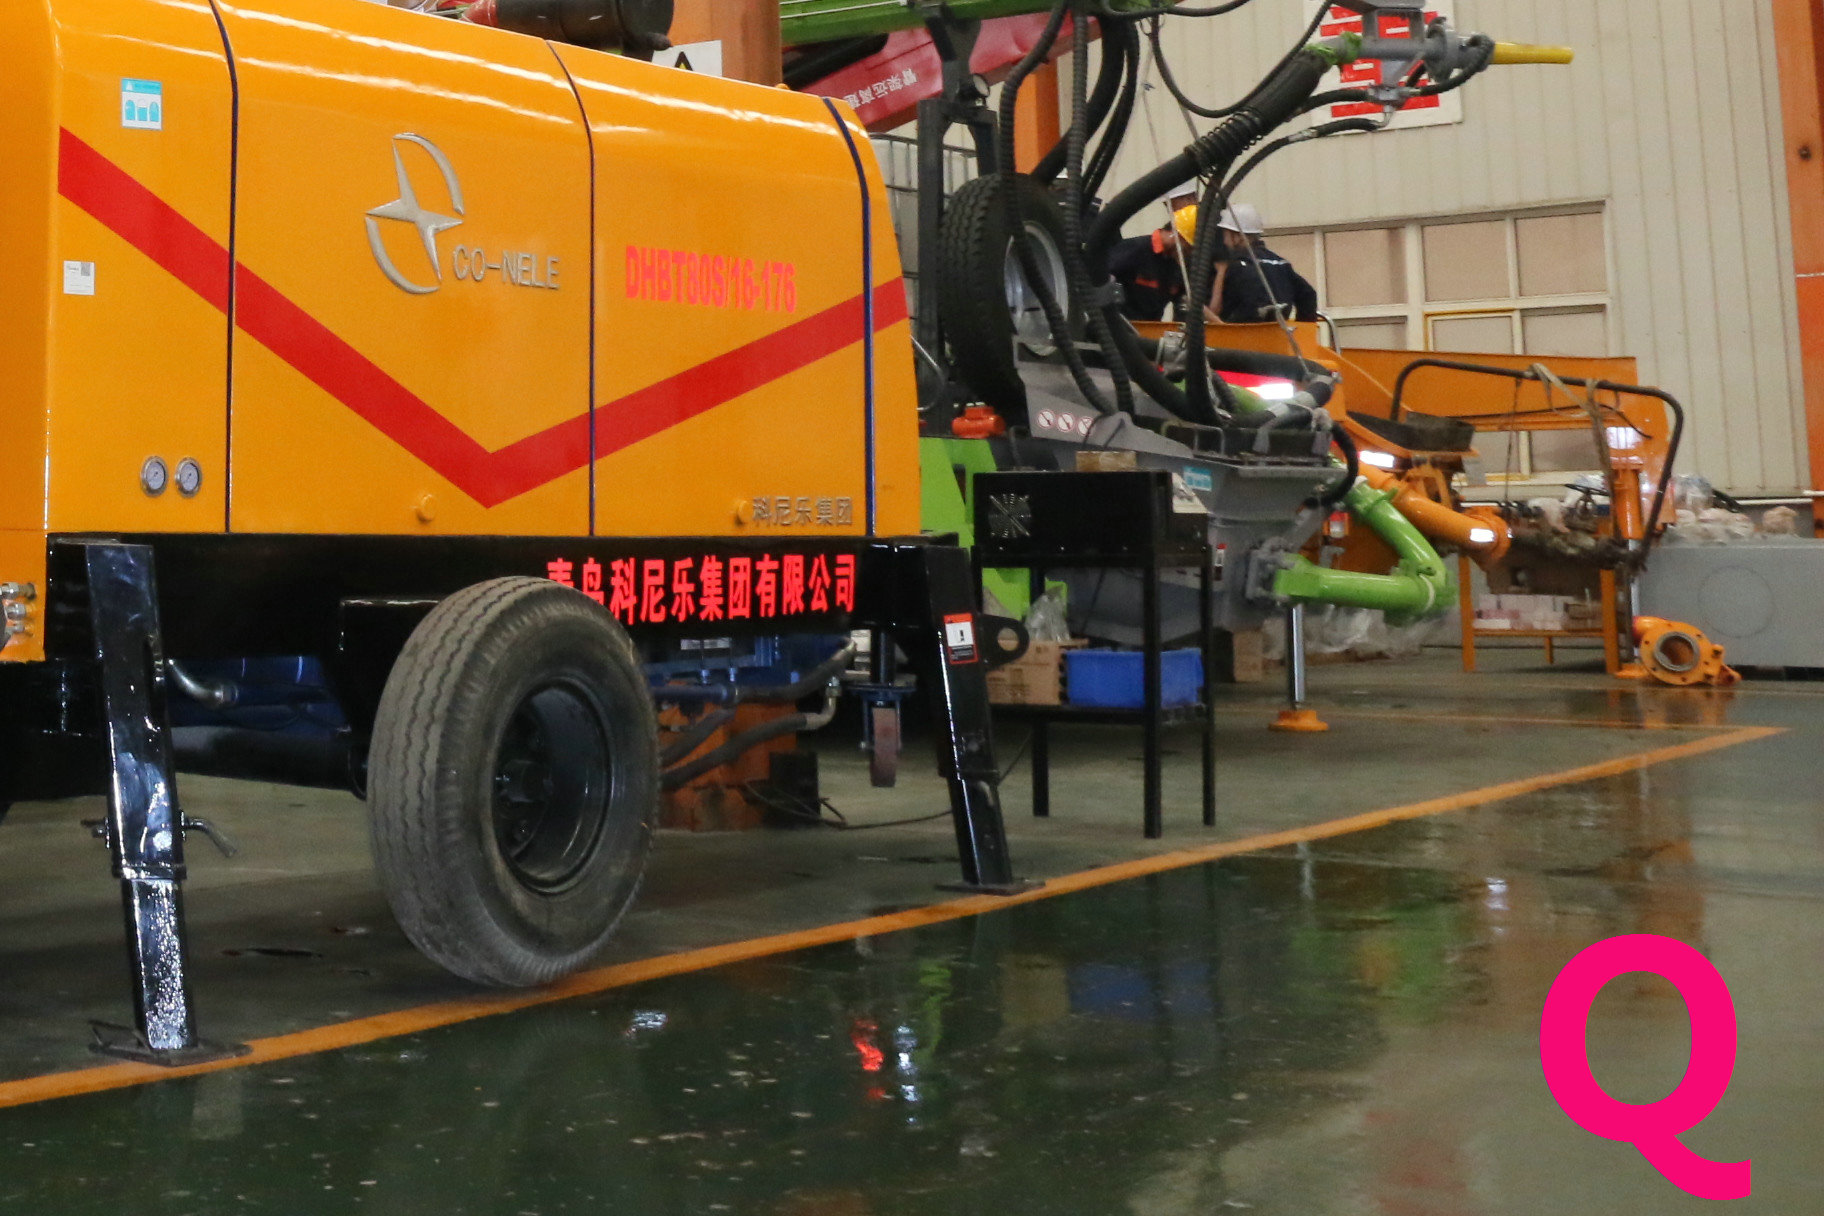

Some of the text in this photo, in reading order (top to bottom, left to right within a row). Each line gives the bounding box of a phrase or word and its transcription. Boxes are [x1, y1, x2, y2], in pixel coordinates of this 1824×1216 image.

[453, 243, 560, 290] CO-NELE
[626, 245, 797, 313] DHBT80S/16-176
[752, 495, 854, 527] 科尼乐集团
